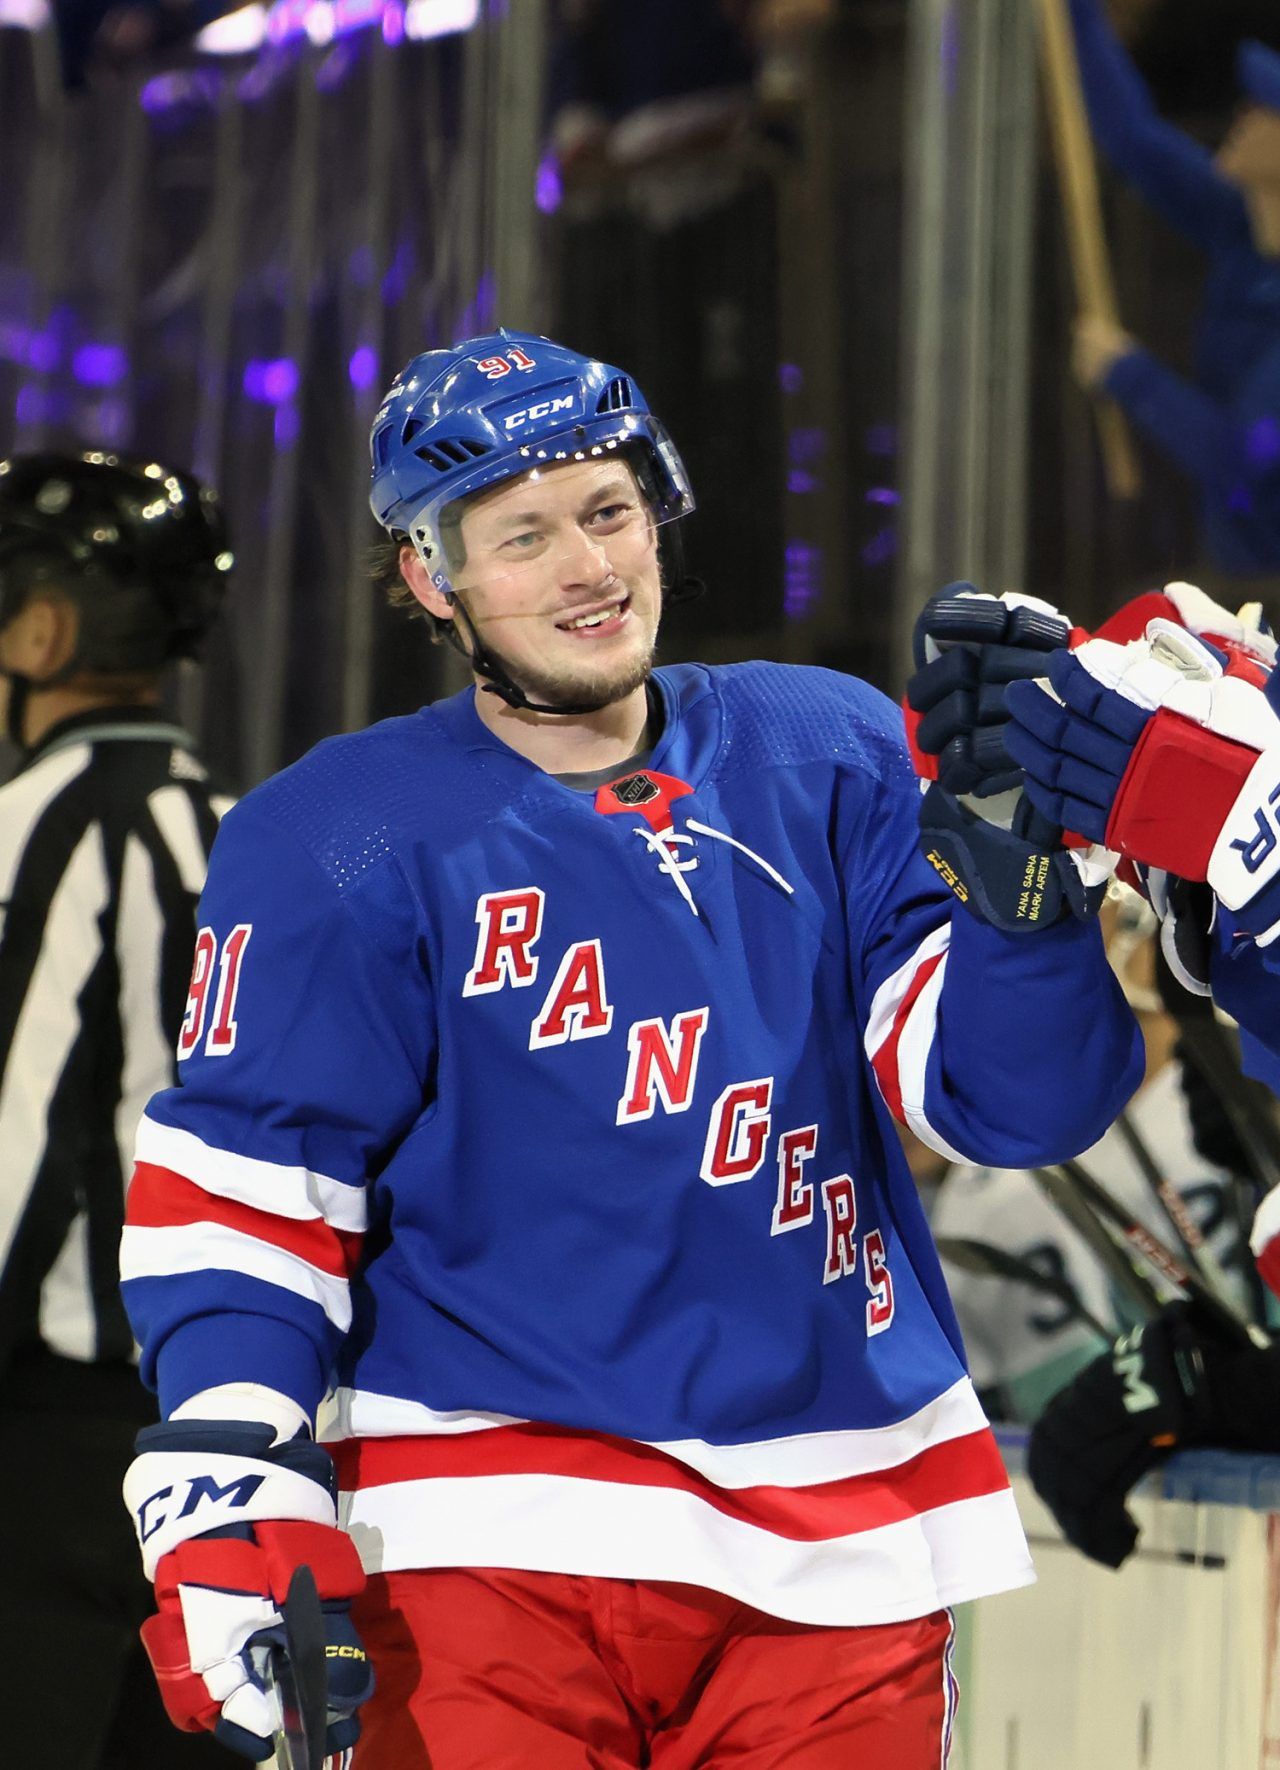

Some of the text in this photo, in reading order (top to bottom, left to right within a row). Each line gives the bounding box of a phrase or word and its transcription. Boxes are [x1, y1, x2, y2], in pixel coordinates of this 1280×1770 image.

[477, 349, 536, 379] 91
[503, 395, 574, 430] CCM
[627, 777, 646, 801] NHL
[1016, 854, 1038, 918] YANA SASHA
[1028, 856, 1051, 921] MARK ARTEM
[176, 923, 253, 1062] 91
[462, 886, 896, 1338] RANGERS
